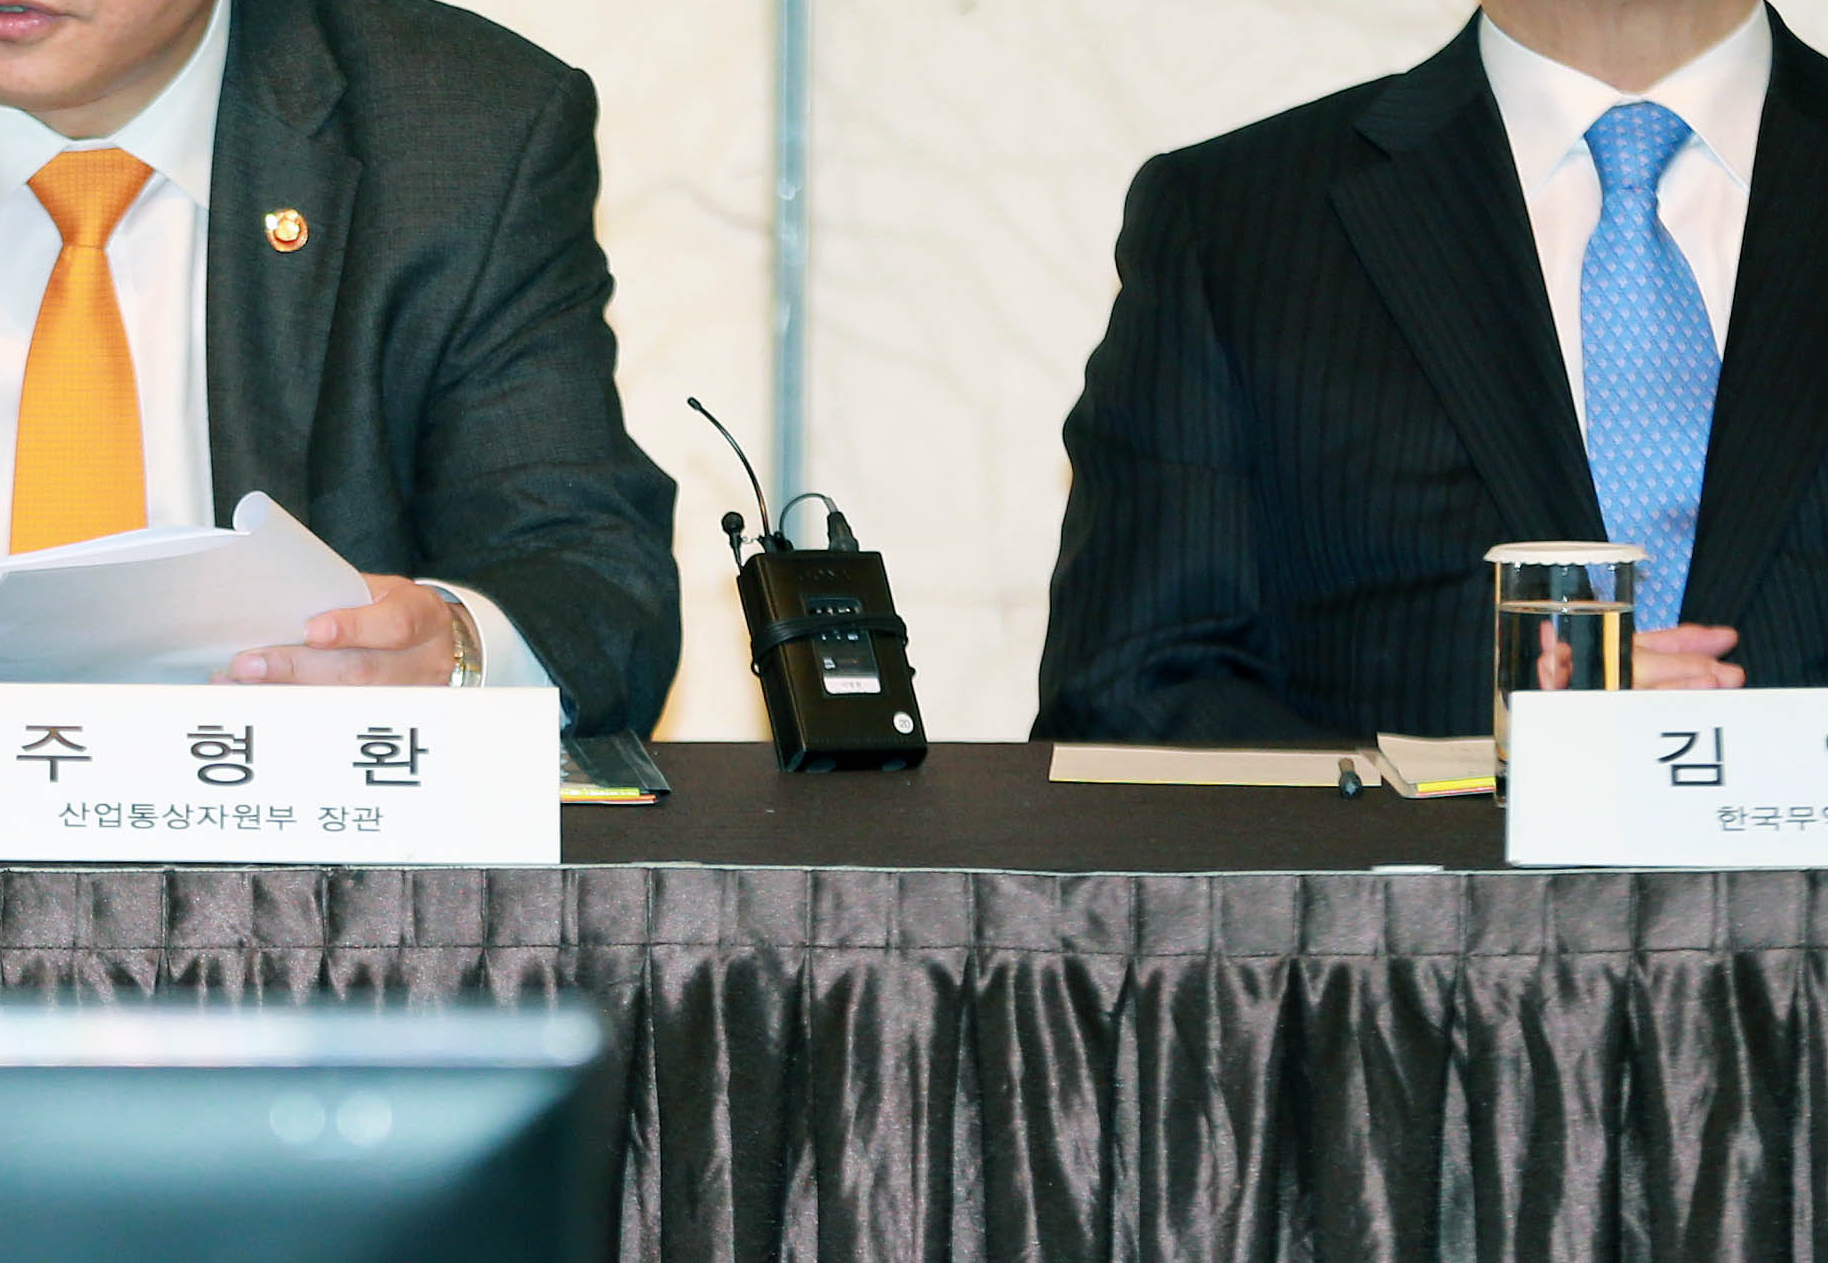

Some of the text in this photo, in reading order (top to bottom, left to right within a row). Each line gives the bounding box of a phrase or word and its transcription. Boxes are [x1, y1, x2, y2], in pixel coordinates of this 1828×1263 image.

[15, 724, 430, 787] 주 형 환
[1656, 726, 1725, 788] 김
[58, 801, 384, 833] 산업통상자원부 장관
[1716, 805, 1828, 833] 한국무
